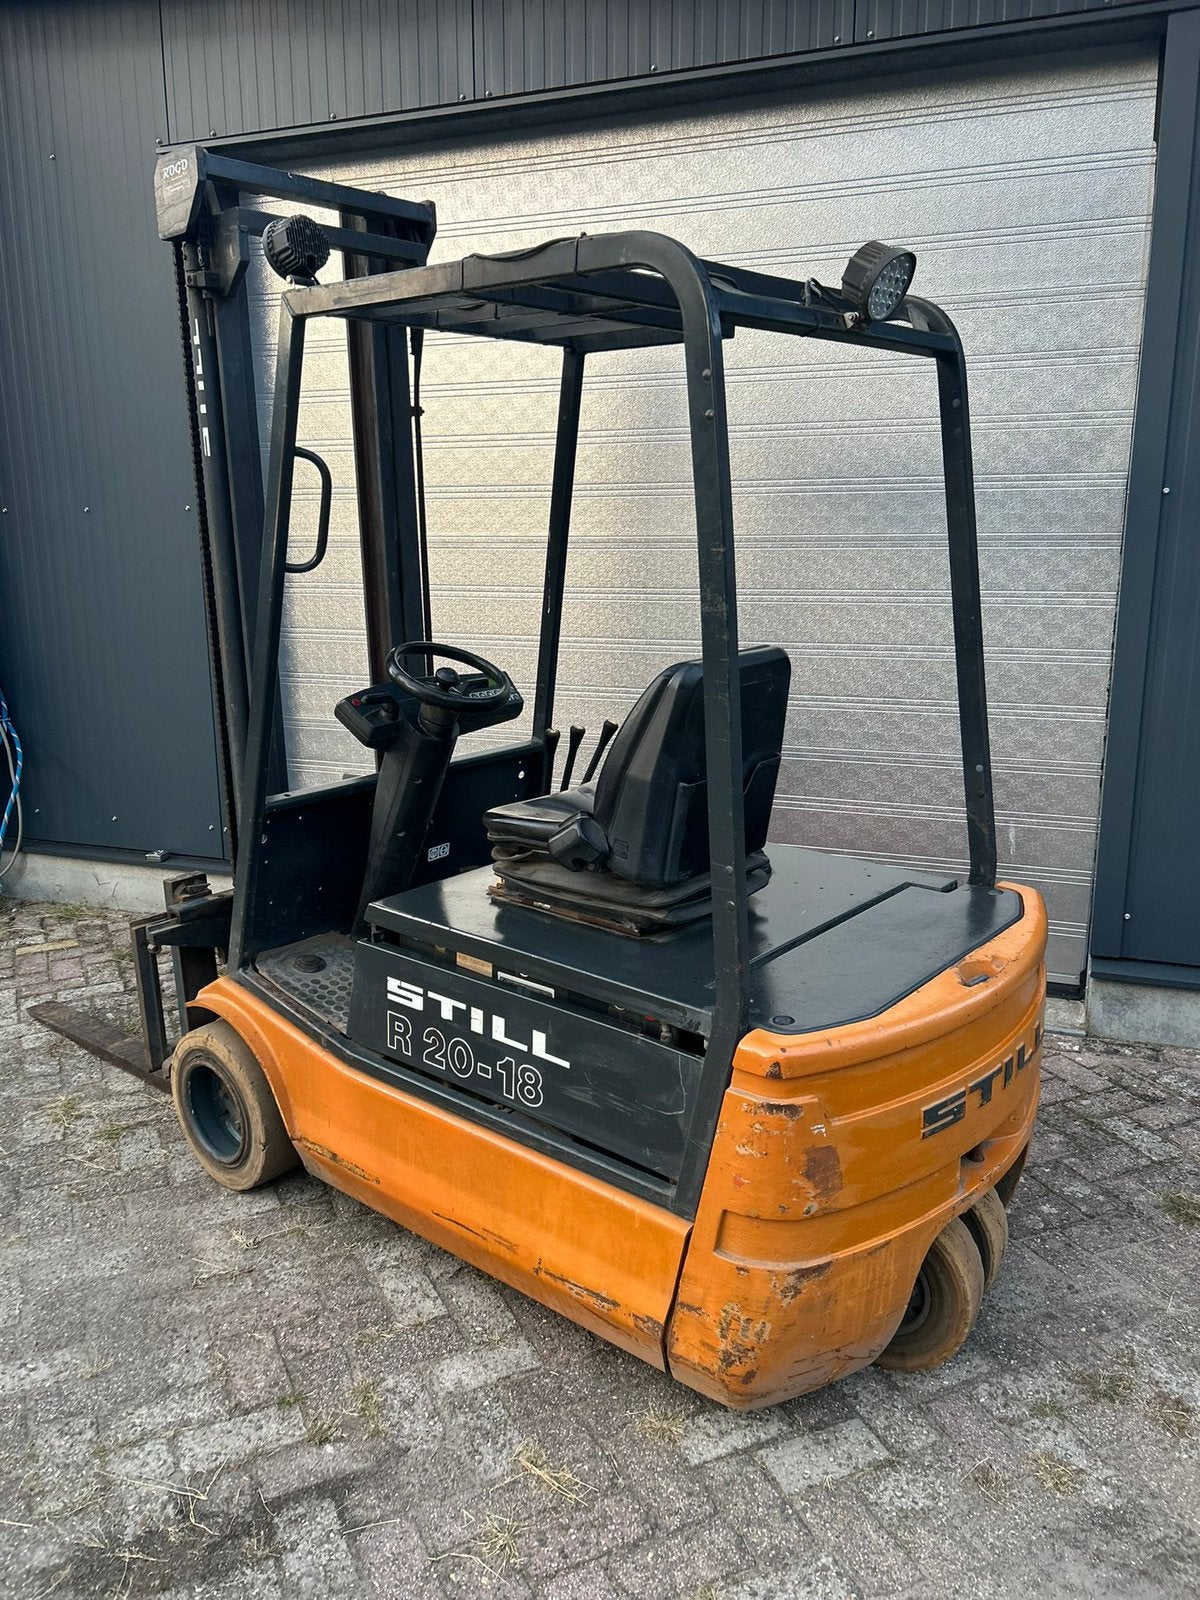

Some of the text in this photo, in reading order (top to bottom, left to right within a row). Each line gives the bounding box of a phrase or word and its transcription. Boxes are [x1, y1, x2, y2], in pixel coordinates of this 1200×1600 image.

[386, 976, 571, 1069] STILL
[387, 1010, 544, 1108] R 20-18
[921, 1020, 1043, 1139] STILL
